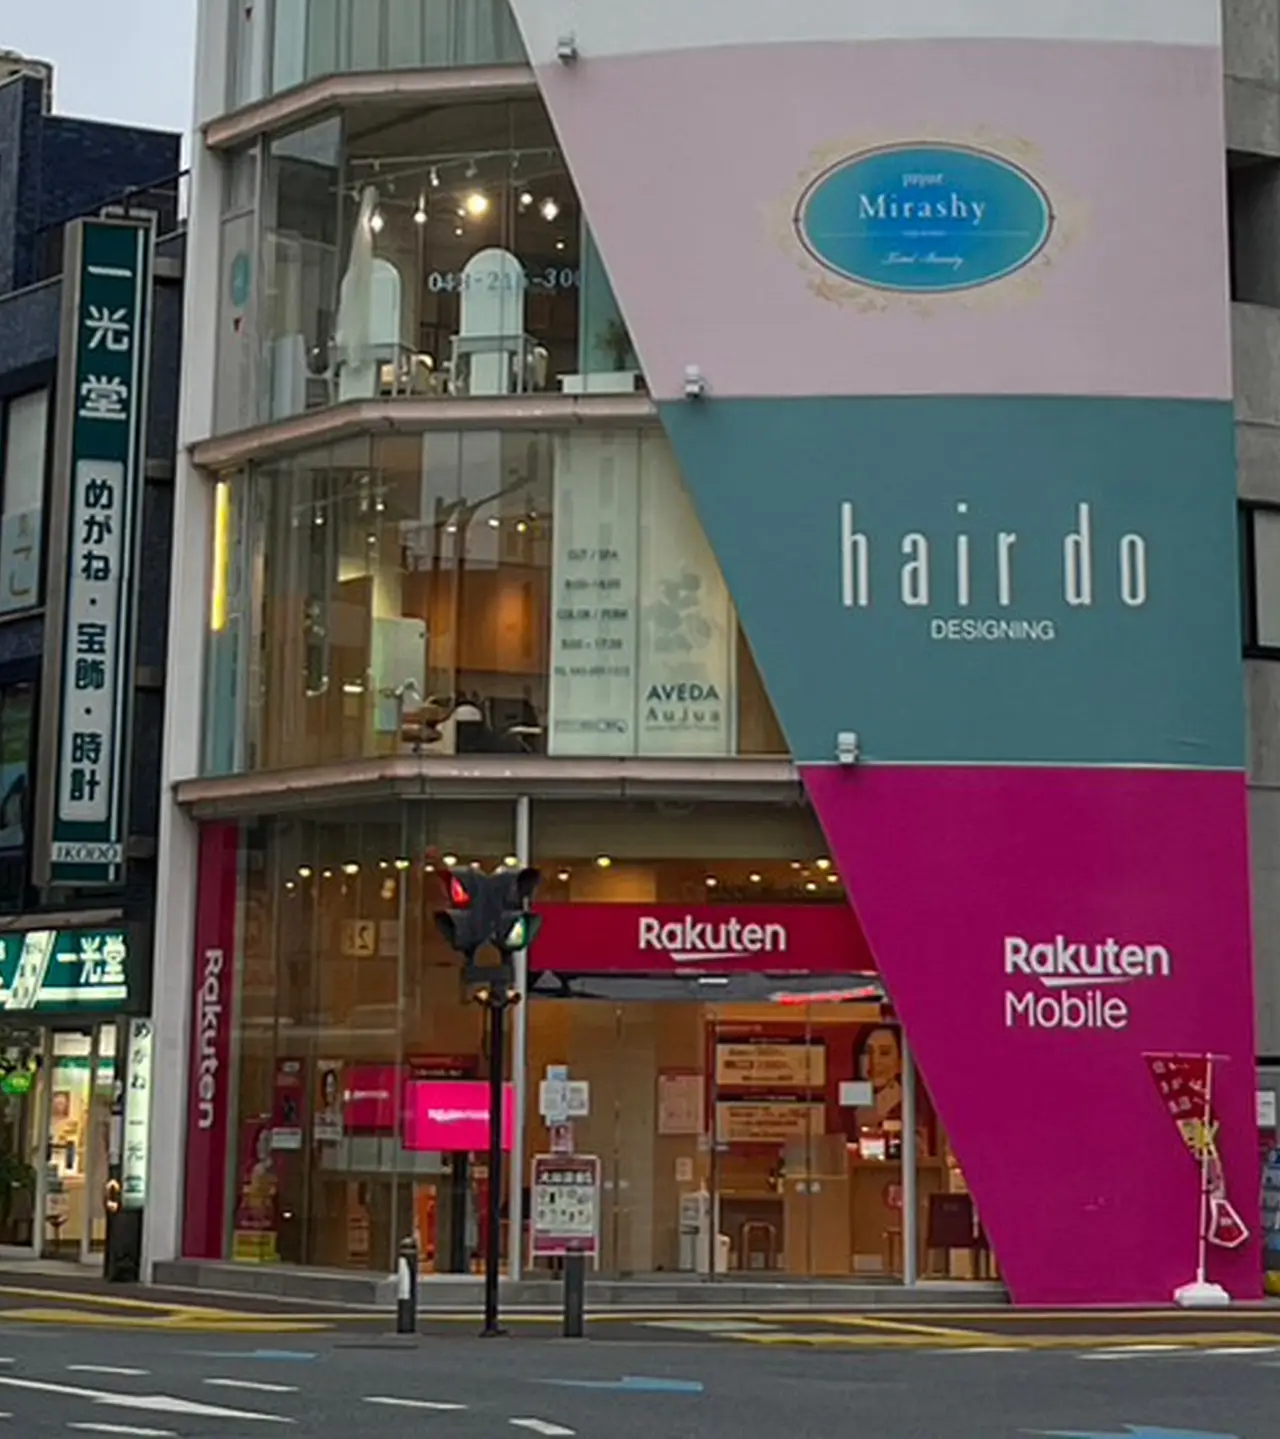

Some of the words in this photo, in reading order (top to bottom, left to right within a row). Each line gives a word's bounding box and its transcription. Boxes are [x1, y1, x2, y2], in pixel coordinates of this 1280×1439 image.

[858, 192, 986, 226] Mirashy
[78, 265, 134, 420] 一光堂
[841, 502, 1017, 607] hair
[1064, 502, 1146, 607] do
[931, 620, 1056, 640] DESIGNING
[646, 683, 720, 702] AVEDA
[638, 916, 787, 956] Rakuten
[57, 934, 126, 984] 一光堂
[1004, 936, 1169, 978] Rakuten
[1004, 990, 1129, 1030] Mobile
[196, 949, 223, 1130] Rakuten
